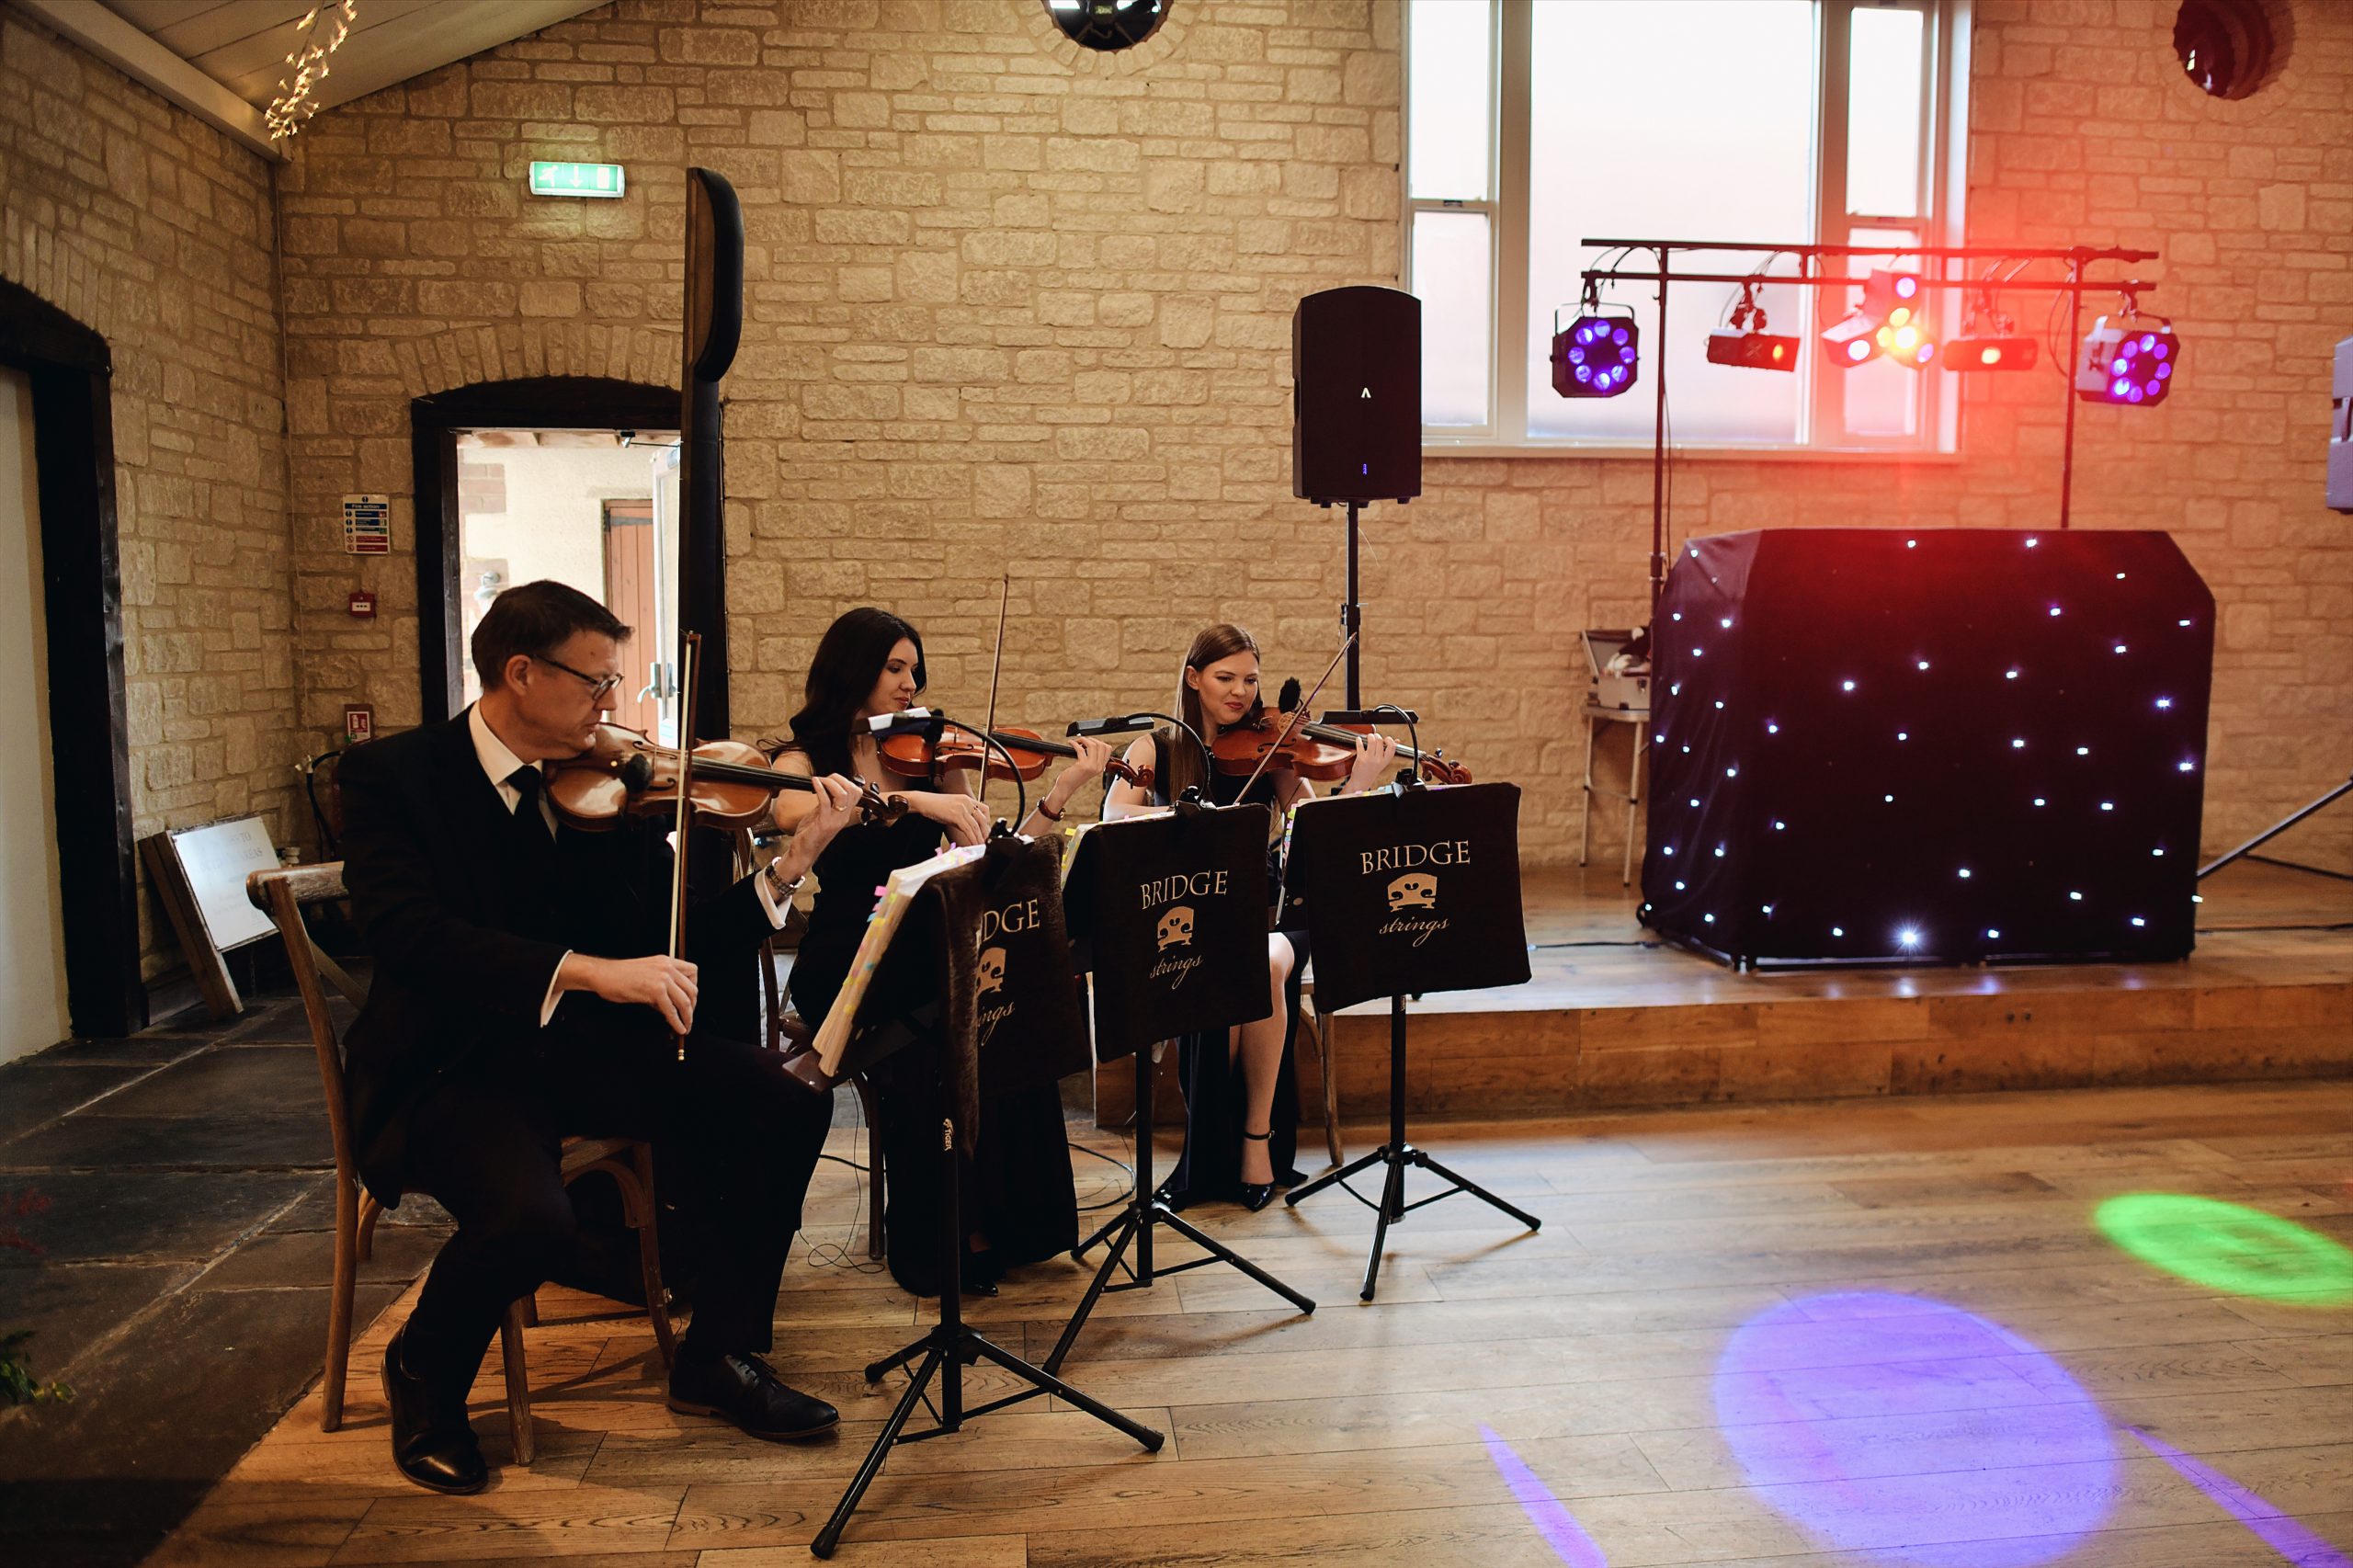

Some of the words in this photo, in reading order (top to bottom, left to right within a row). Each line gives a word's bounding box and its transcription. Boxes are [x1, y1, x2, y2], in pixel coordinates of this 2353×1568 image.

[1360, 840, 1471, 874] BRIDGE
[1140, 869, 1228, 910] BRIDGE
[1379, 916, 1449, 948] strings
[1150, 955, 1204, 990] strings
[977, 1001, 1016, 1047] ings
